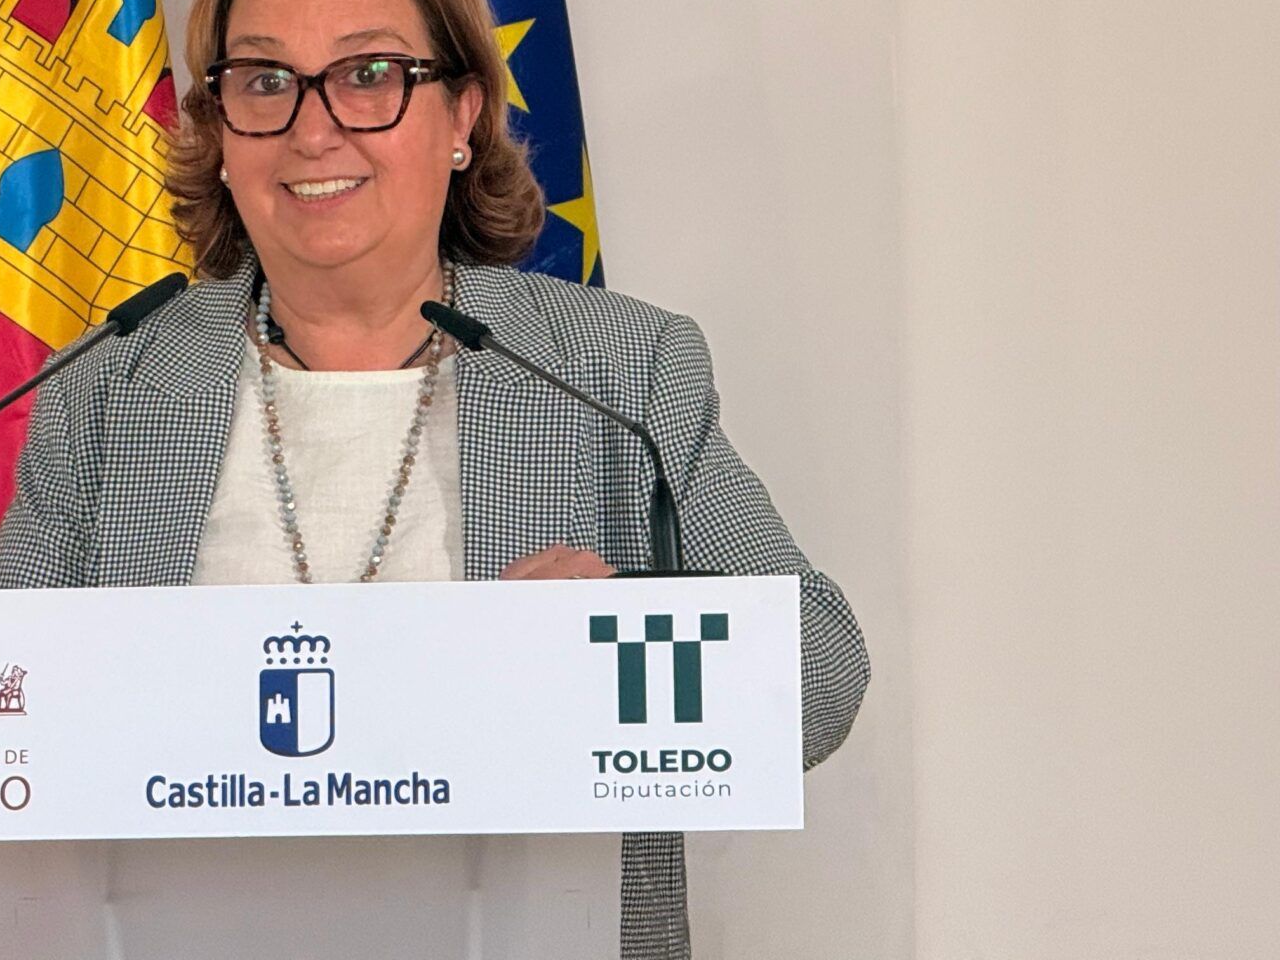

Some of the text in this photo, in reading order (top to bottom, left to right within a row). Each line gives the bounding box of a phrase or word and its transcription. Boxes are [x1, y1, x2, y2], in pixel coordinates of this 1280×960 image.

[5, 749, 29, 765] DE
[591, 748, 733, 774] TOLEDO
[327, 771, 451, 807] Mancha
[593, 779, 732, 802] Diputación
